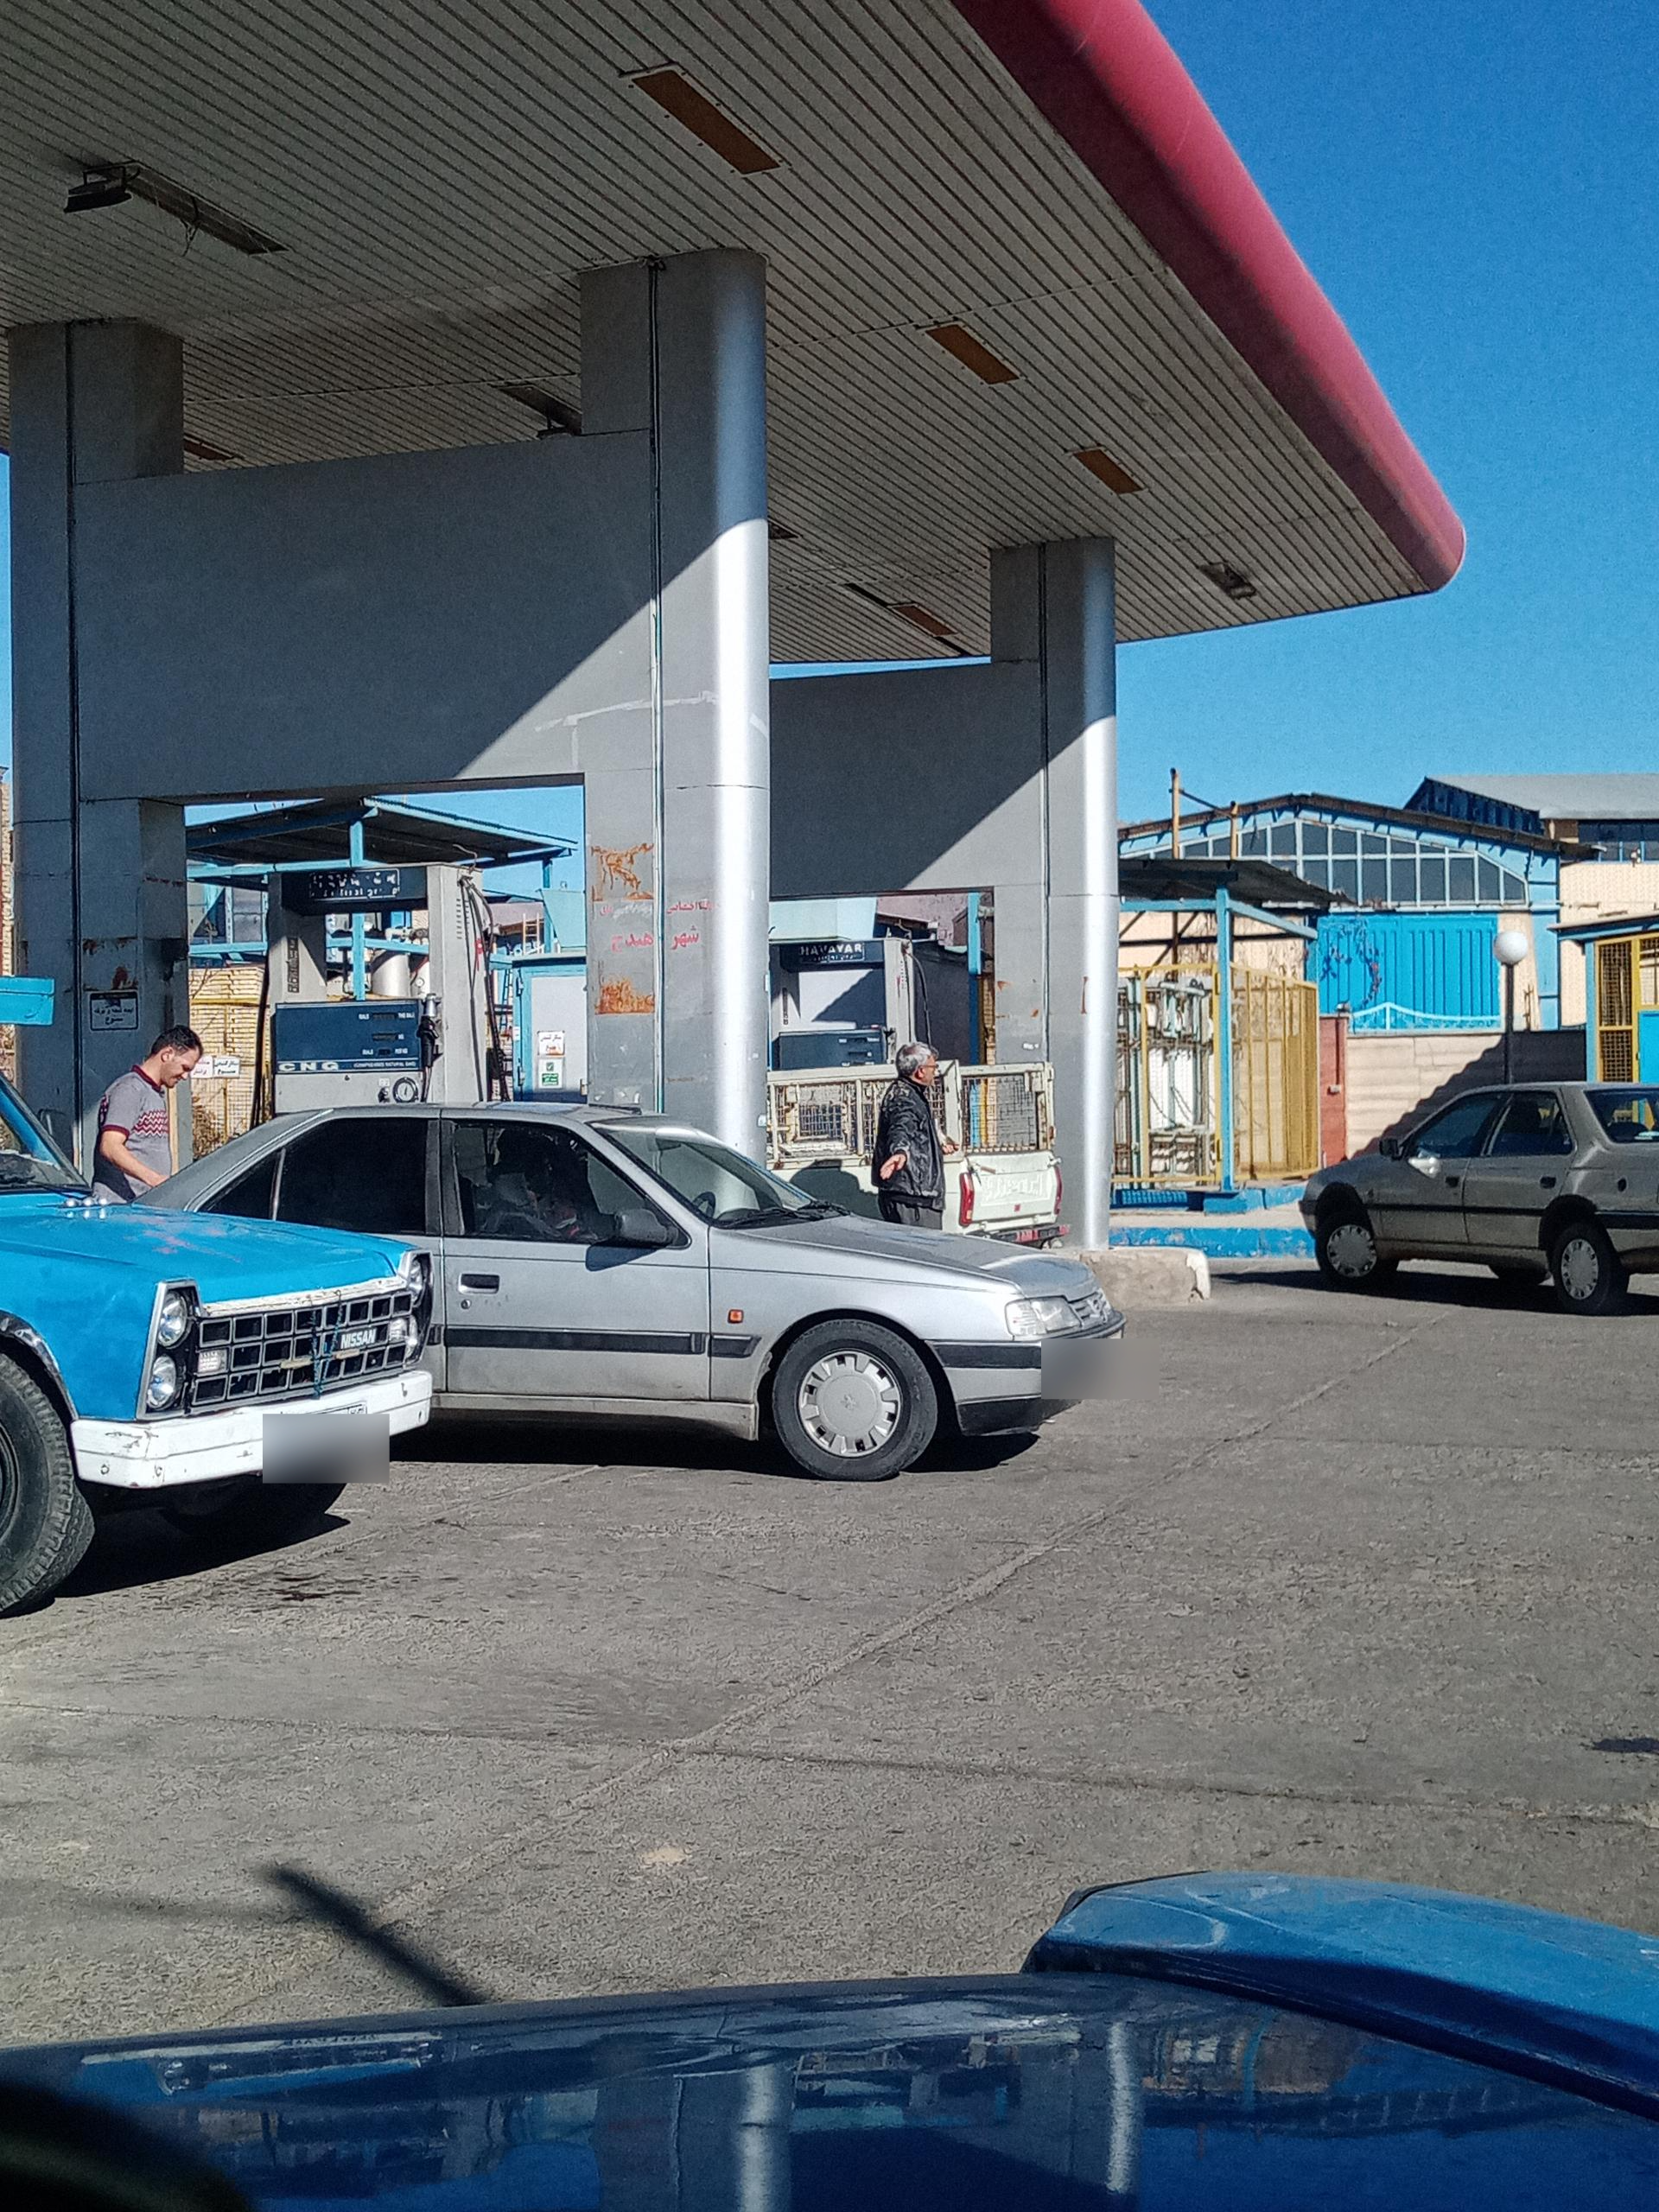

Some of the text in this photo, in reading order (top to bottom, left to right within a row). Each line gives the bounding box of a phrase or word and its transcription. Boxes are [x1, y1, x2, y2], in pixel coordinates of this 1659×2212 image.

[671, 925, 699, 950] شهر
[278, 1062, 339, 1071] CNG
[340, 1327, 377, 1349] NISSAN
